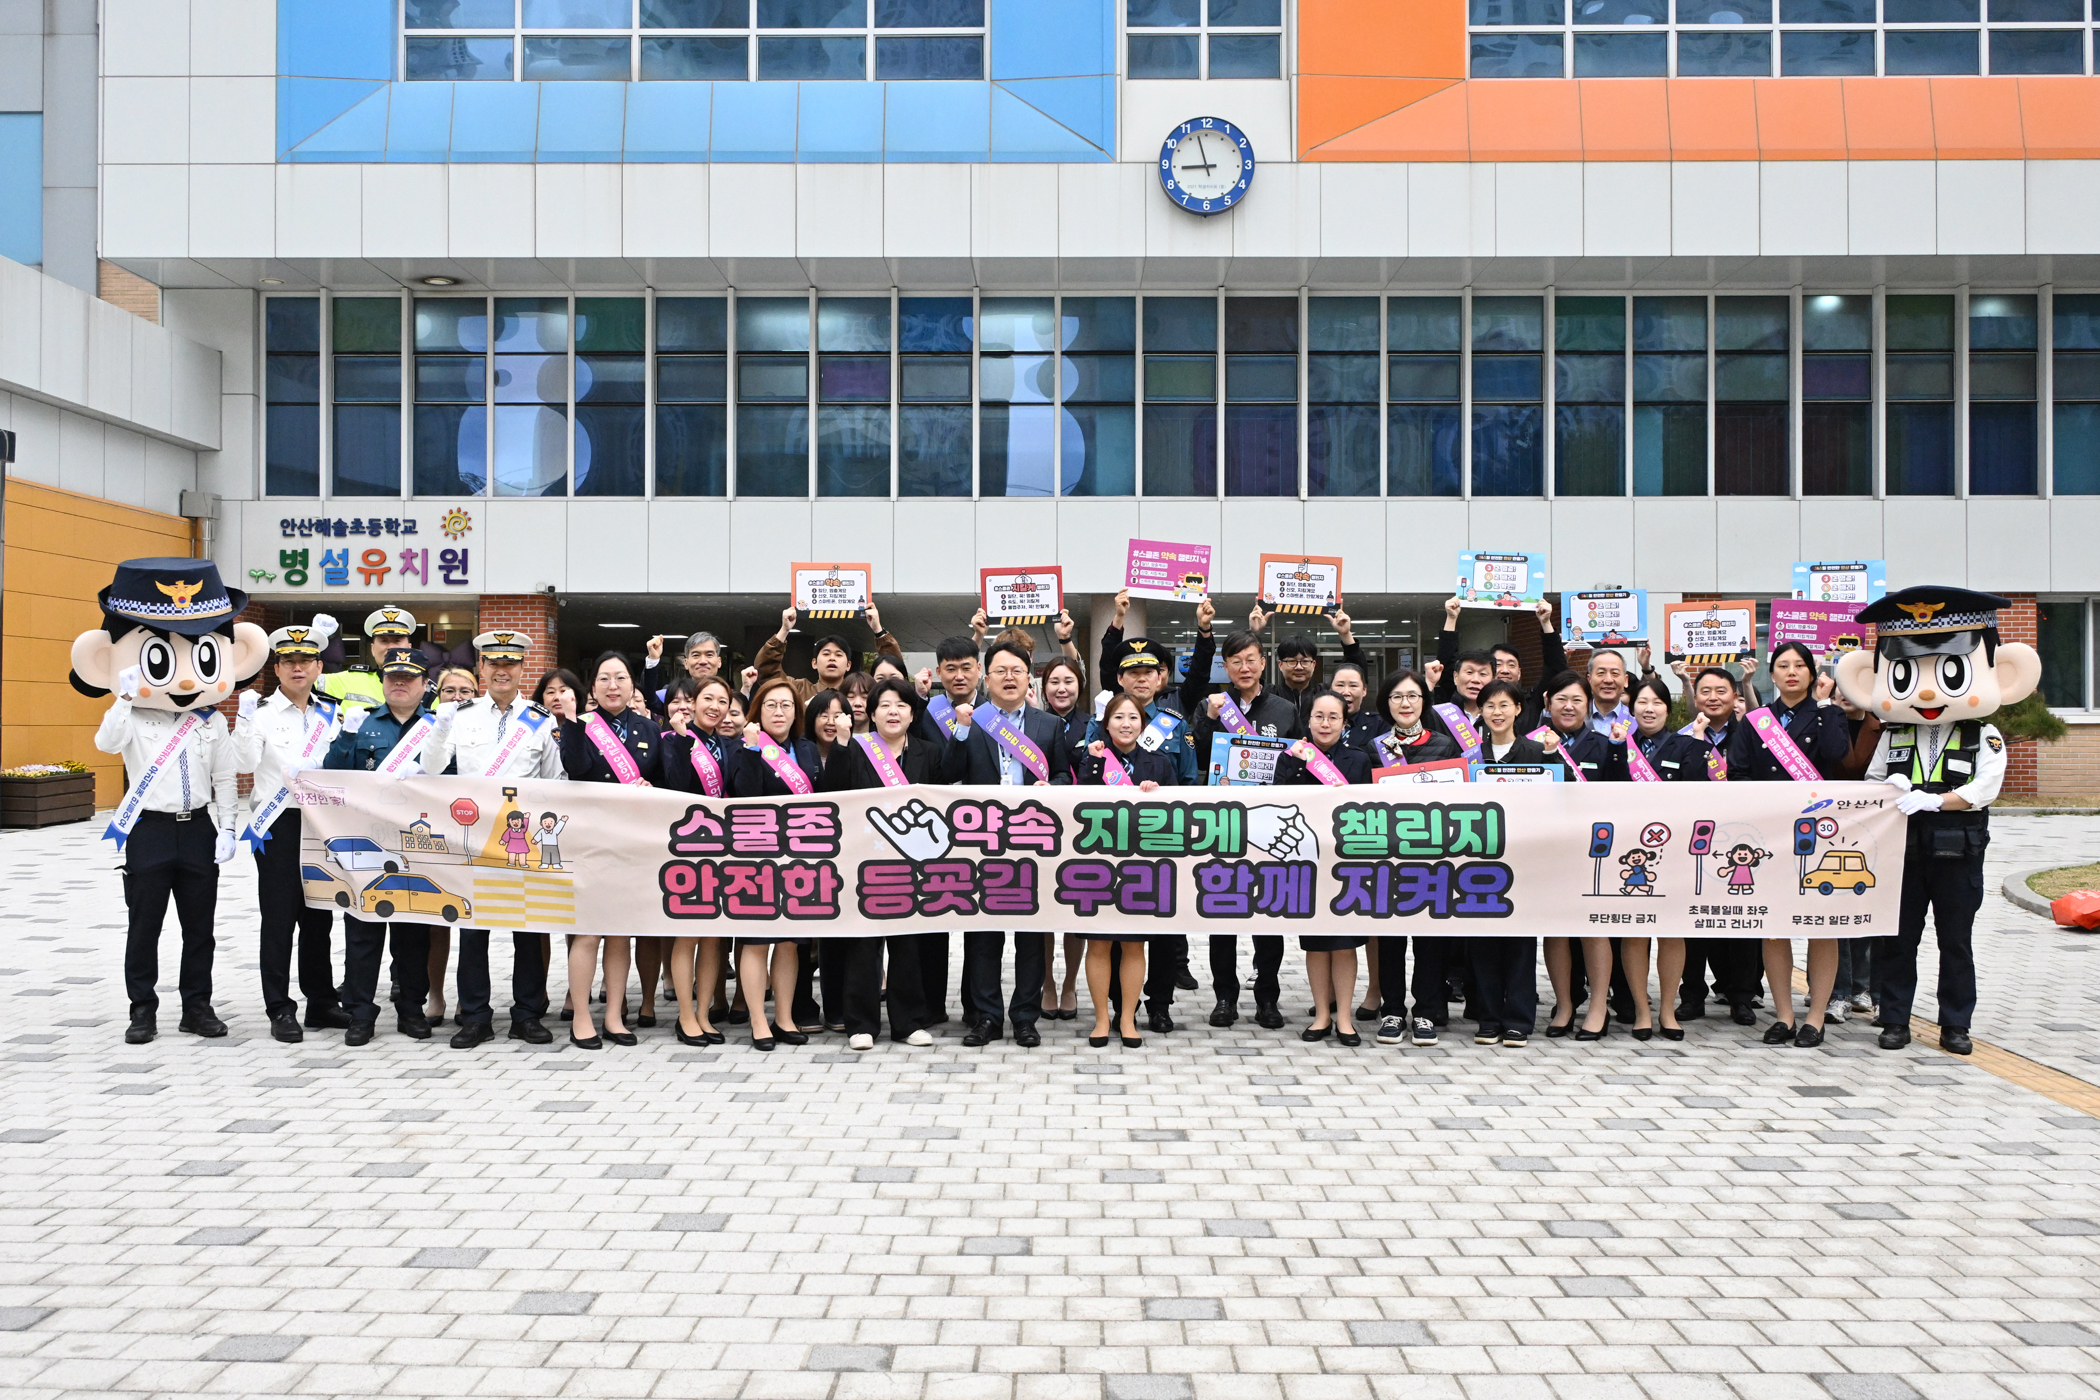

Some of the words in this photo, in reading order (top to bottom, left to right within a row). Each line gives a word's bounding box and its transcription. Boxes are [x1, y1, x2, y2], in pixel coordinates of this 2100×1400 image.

[1201, 118, 1213, 128] 12
[1224, 124, 1230, 133] 1
[1181, 124, 1191, 134] 11
[1166, 139, 1177, 148] 10
[1240, 138, 1246, 148] 2
[1162, 160, 1169, 169] 9
[1245, 160, 1252, 169] 3
[1168, 180, 1174, 189] 8
[1238, 180, 1246, 189] 4
[1182, 195, 1188, 204] 7
[1224, 196, 1231, 205] 5
[1203, 201, 1210, 210] 6
[280, 518, 418, 537] 안산해솔초등학교
[280, 548, 469, 586] 병설유치원
[1777, 611, 1807, 620] #스쿨존
[1809, 612, 1827, 621] 약속
[1829, 613, 1854, 622] 챌린지
[176, 721, 195, 739] 안전한
[410, 726, 429, 745] 안전한
[1456, 723, 1475, 747] 안전한
[508, 728, 525, 747] 안전한
[589, 720, 620, 759] 스쿨존에서는
[614, 755, 634, 778] 어린이가
[694, 749, 719, 788] 스쿨존에서는
[778, 760, 804, 792] 스쿨존에서는
[294, 793, 328, 805] 안전한
[1837, 799, 1883, 810] 안산시
[119, 797, 138, 827] 만들어요
[252, 801, 277, 830] 만들어요
[671, 804, 839, 856] 스쿨존
[948, 801, 1061, 854] 약속
[1076, 804, 1244, 856] 지킬게
[1335, 804, 1502, 858] 챌린지
[661, 862, 841, 917] 안전한
[860, 860, 1036, 914] 등굣길
[1057, 861, 1175, 914] 우리
[1196, 860, 1314, 917] 함께
[1332, 862, 1512, 917] 지켜요
[1689, 906, 1743, 915] 초록불일때
[1747, 906, 1768, 916] 좌우
[1589, 914, 1632, 924] 무단횡단
[1636, 914, 1656, 924] 금지
[1694, 919, 1727, 929] 살피고
[1731, 919, 1763, 929] 건너기
[1792, 915, 1824, 925] 무조건
[1829, 916, 1850, 925] 일단
[1853, 914, 1872, 924] 정지
